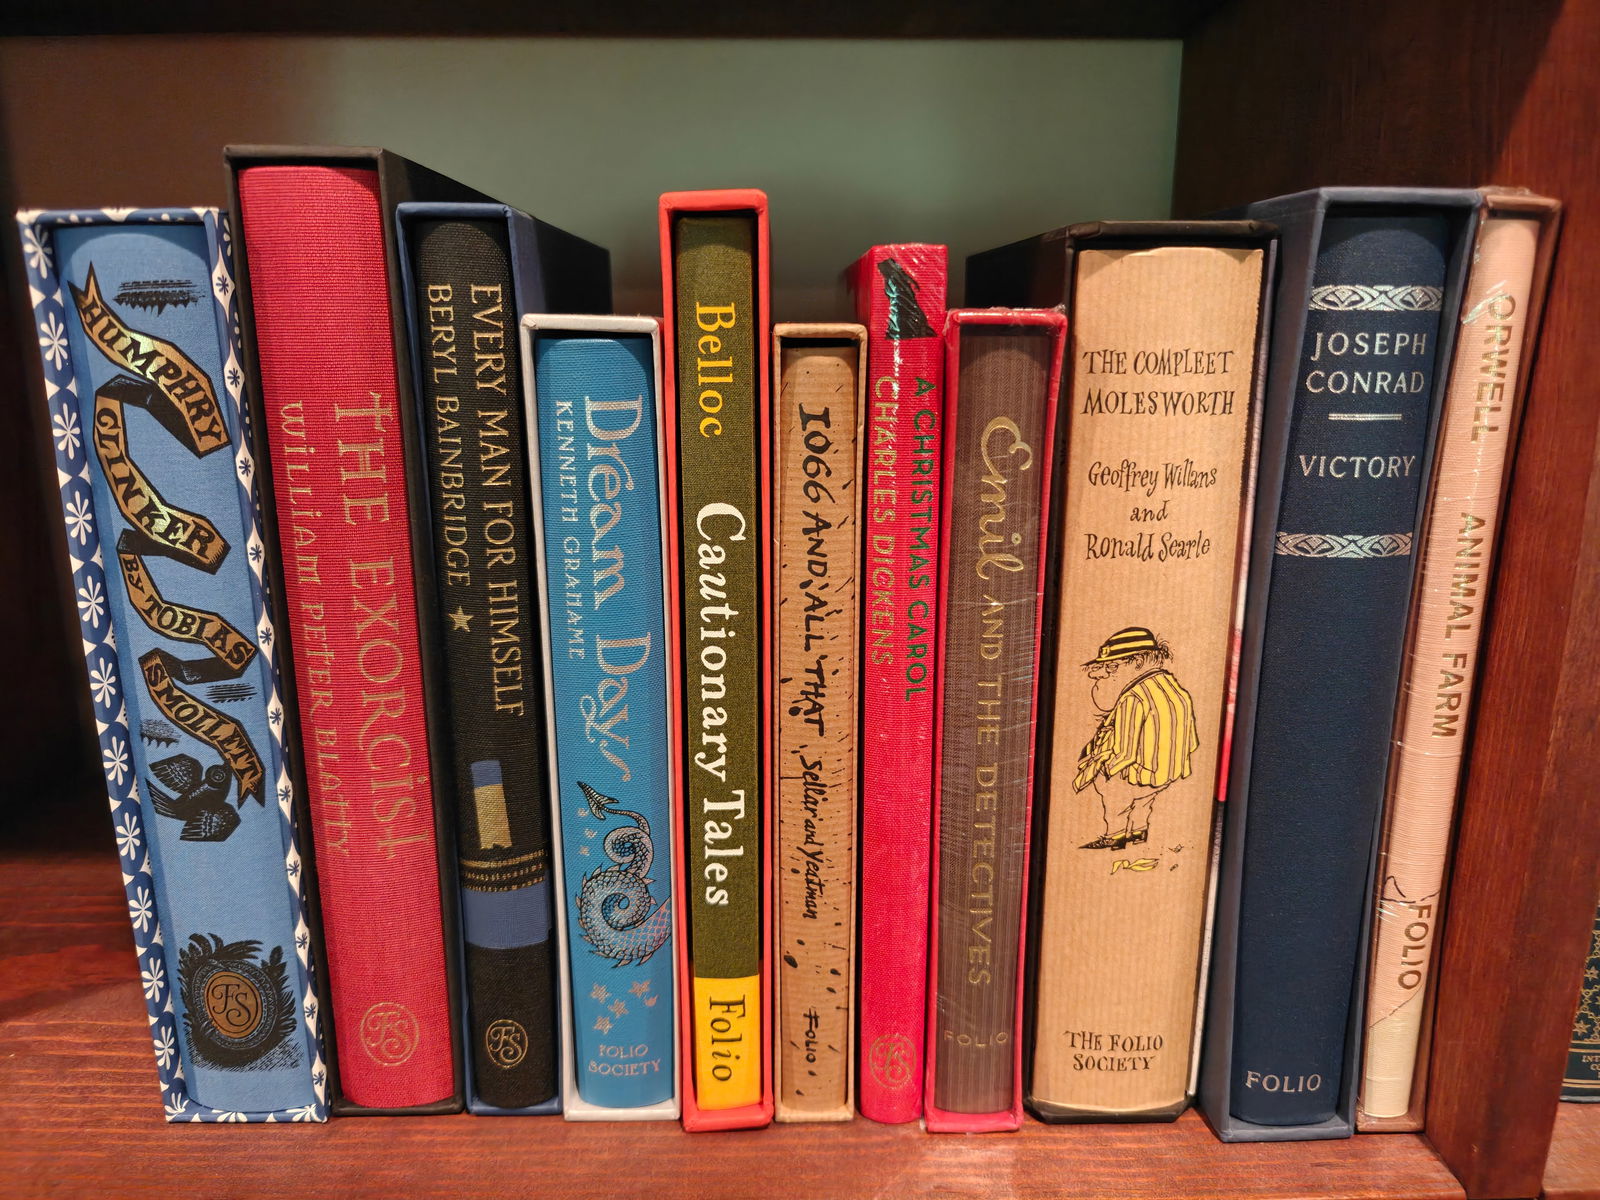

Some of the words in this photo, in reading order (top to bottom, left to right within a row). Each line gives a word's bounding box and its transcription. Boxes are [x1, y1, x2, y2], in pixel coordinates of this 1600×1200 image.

[82, 302, 222, 443] HUMPHRY
[427, 284, 458, 384] BERYL
[470, 284, 507, 396] EVERY
[696, 301, 736, 438] Belloc
[1082, 349, 1127, 375] THE
[1133, 348, 1234, 377] COMPLEET
[1310, 332, 1427, 361] JOSEPH
[1470, 295, 1516, 444] ORWELL
[915, 376, 936, 397] A
[1080, 387, 1236, 417] MOLESWORTH
[1305, 370, 1425, 394] CONRAD
[96, 407, 216, 560] CLINKER
[334, 391, 393, 525] THE
[436, 395, 471, 587] BAINBRIDGE
[477, 409, 512, 487] MAN
[555, 400, 579, 523] KENNETH
[873, 375, 899, 524] CHARLES
[1088, 458, 1159, 497] Geoffrey
[1162, 458, 1217, 490] Willans
[1299, 455, 1416, 479] VICTORY
[483, 500, 516, 569] FOR
[584, 394, 643, 611] Dream
[908, 409, 937, 589] CHRISTMAS
[976, 415, 1033, 580] Emil
[1130, 500, 1170, 522] and
[802, 510, 832, 578] AND
[1084, 533, 1155, 563] Ronald
[1158, 531, 1211, 563] Searle
[1444, 511, 1486, 640] ANIMAL
[141, 593, 255, 665] TOBIAS
[562, 536, 585, 660] GRAHAME
[804, 591, 829, 652] ALL
[871, 535, 895, 665] DICKENS
[980, 594, 1004, 660] AND
[301, 601, 335, 722] PETER
[488, 579, 524, 717] HIMSELF
[694, 502, 746, 782] Cautionary
[905, 600, 930, 702] CAROL
[145, 662, 262, 780] SMOLLETT
[350, 556, 429, 859] EXORCIST
[578, 632, 651, 782] Days
[800, 658, 827, 737] THAT
[977, 673, 1002, 745] THE
[1431, 652, 1468, 738] FARM
[314, 727, 352, 857] BLATTY
[799, 755, 829, 818] Sellar
[703, 789, 745, 906] Tales
[803, 818, 825, 847] and
[969, 761, 998, 985] DETECTIVES
[796, 846, 826, 920] Yeatman
[1398, 903, 1432, 990] FOLIO
[588, 1058, 661, 1077] SOCIETY
[599, 1044, 649, 1060] FOLIO
[709, 994, 746, 1082] Folio
[944, 1030, 1009, 1048] FOLIO
[1063, 1030, 1103, 1051] THE
[1108, 1033, 1163, 1052] FOLIO
[1073, 1053, 1156, 1072] SOCIETY
[1245, 1070, 1322, 1093] FOLIO
